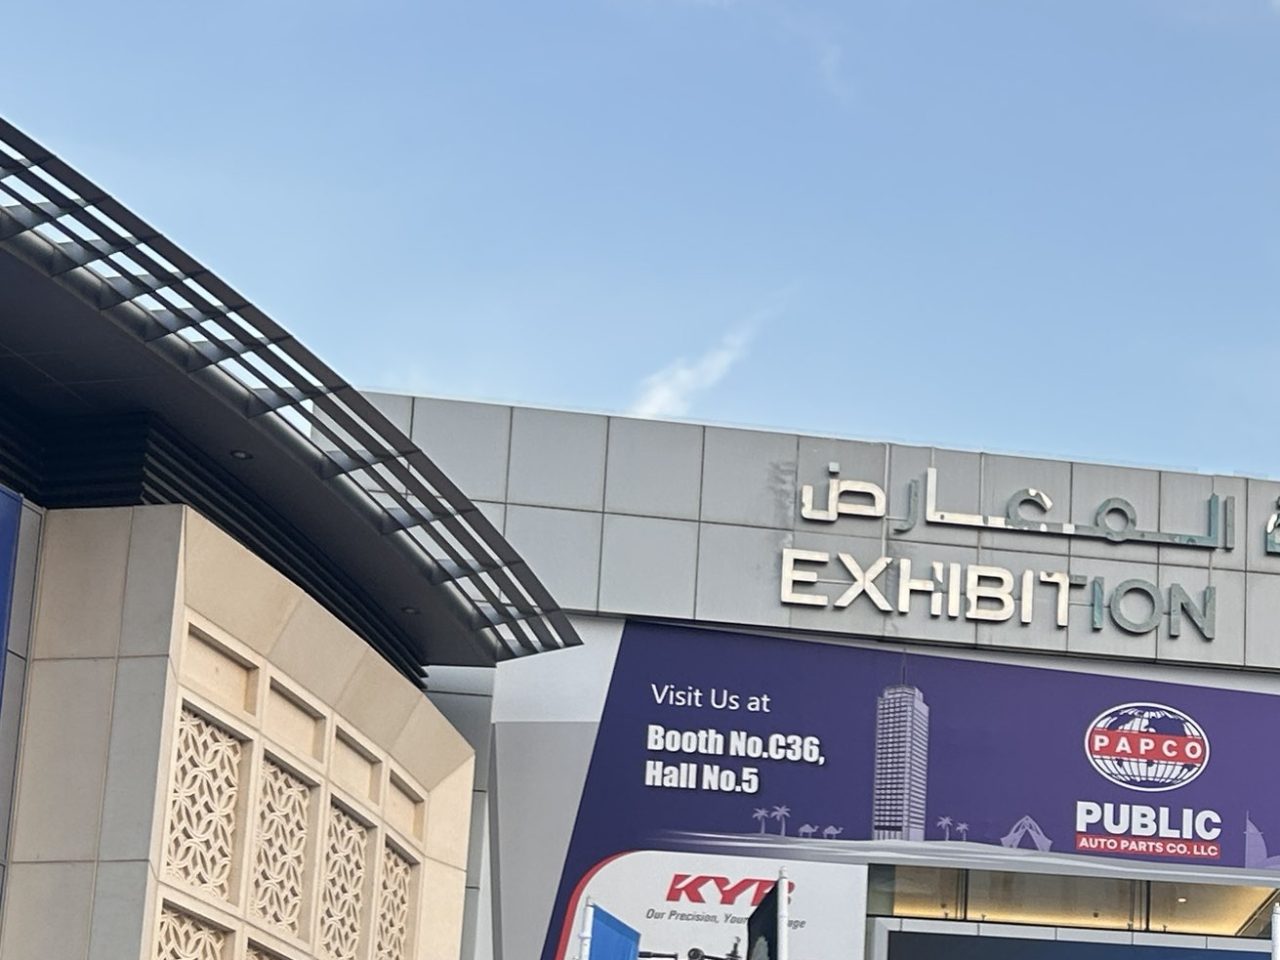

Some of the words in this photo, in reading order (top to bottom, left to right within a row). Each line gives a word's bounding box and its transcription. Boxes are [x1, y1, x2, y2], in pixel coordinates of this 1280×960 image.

[780, 548, 1216, 640] EXHIBITION
[650, 684, 703, 709] Visit
[710, 688, 739, 711] Us
[747, 692, 771, 713] at
[646, 724, 724, 758] Booth
[729, 730, 826, 767] No.C36,
[1093, 734, 1202, 759] PAPCO
[645, 760, 697, 790] Hall
[702, 763, 760, 794] No.5
[1074, 800, 1222, 841] PUBLIC
[1078, 837, 1118, 850] AUTO
[1120, 840, 1164, 853] PARTS
[1166, 843, 1191, 855] CO.
[1193, 844, 1218, 856] LLC
[646, 908, 665, 920] Our
[668, 909, 719, 924] Precision,
[724, 912, 749, 925] Your
